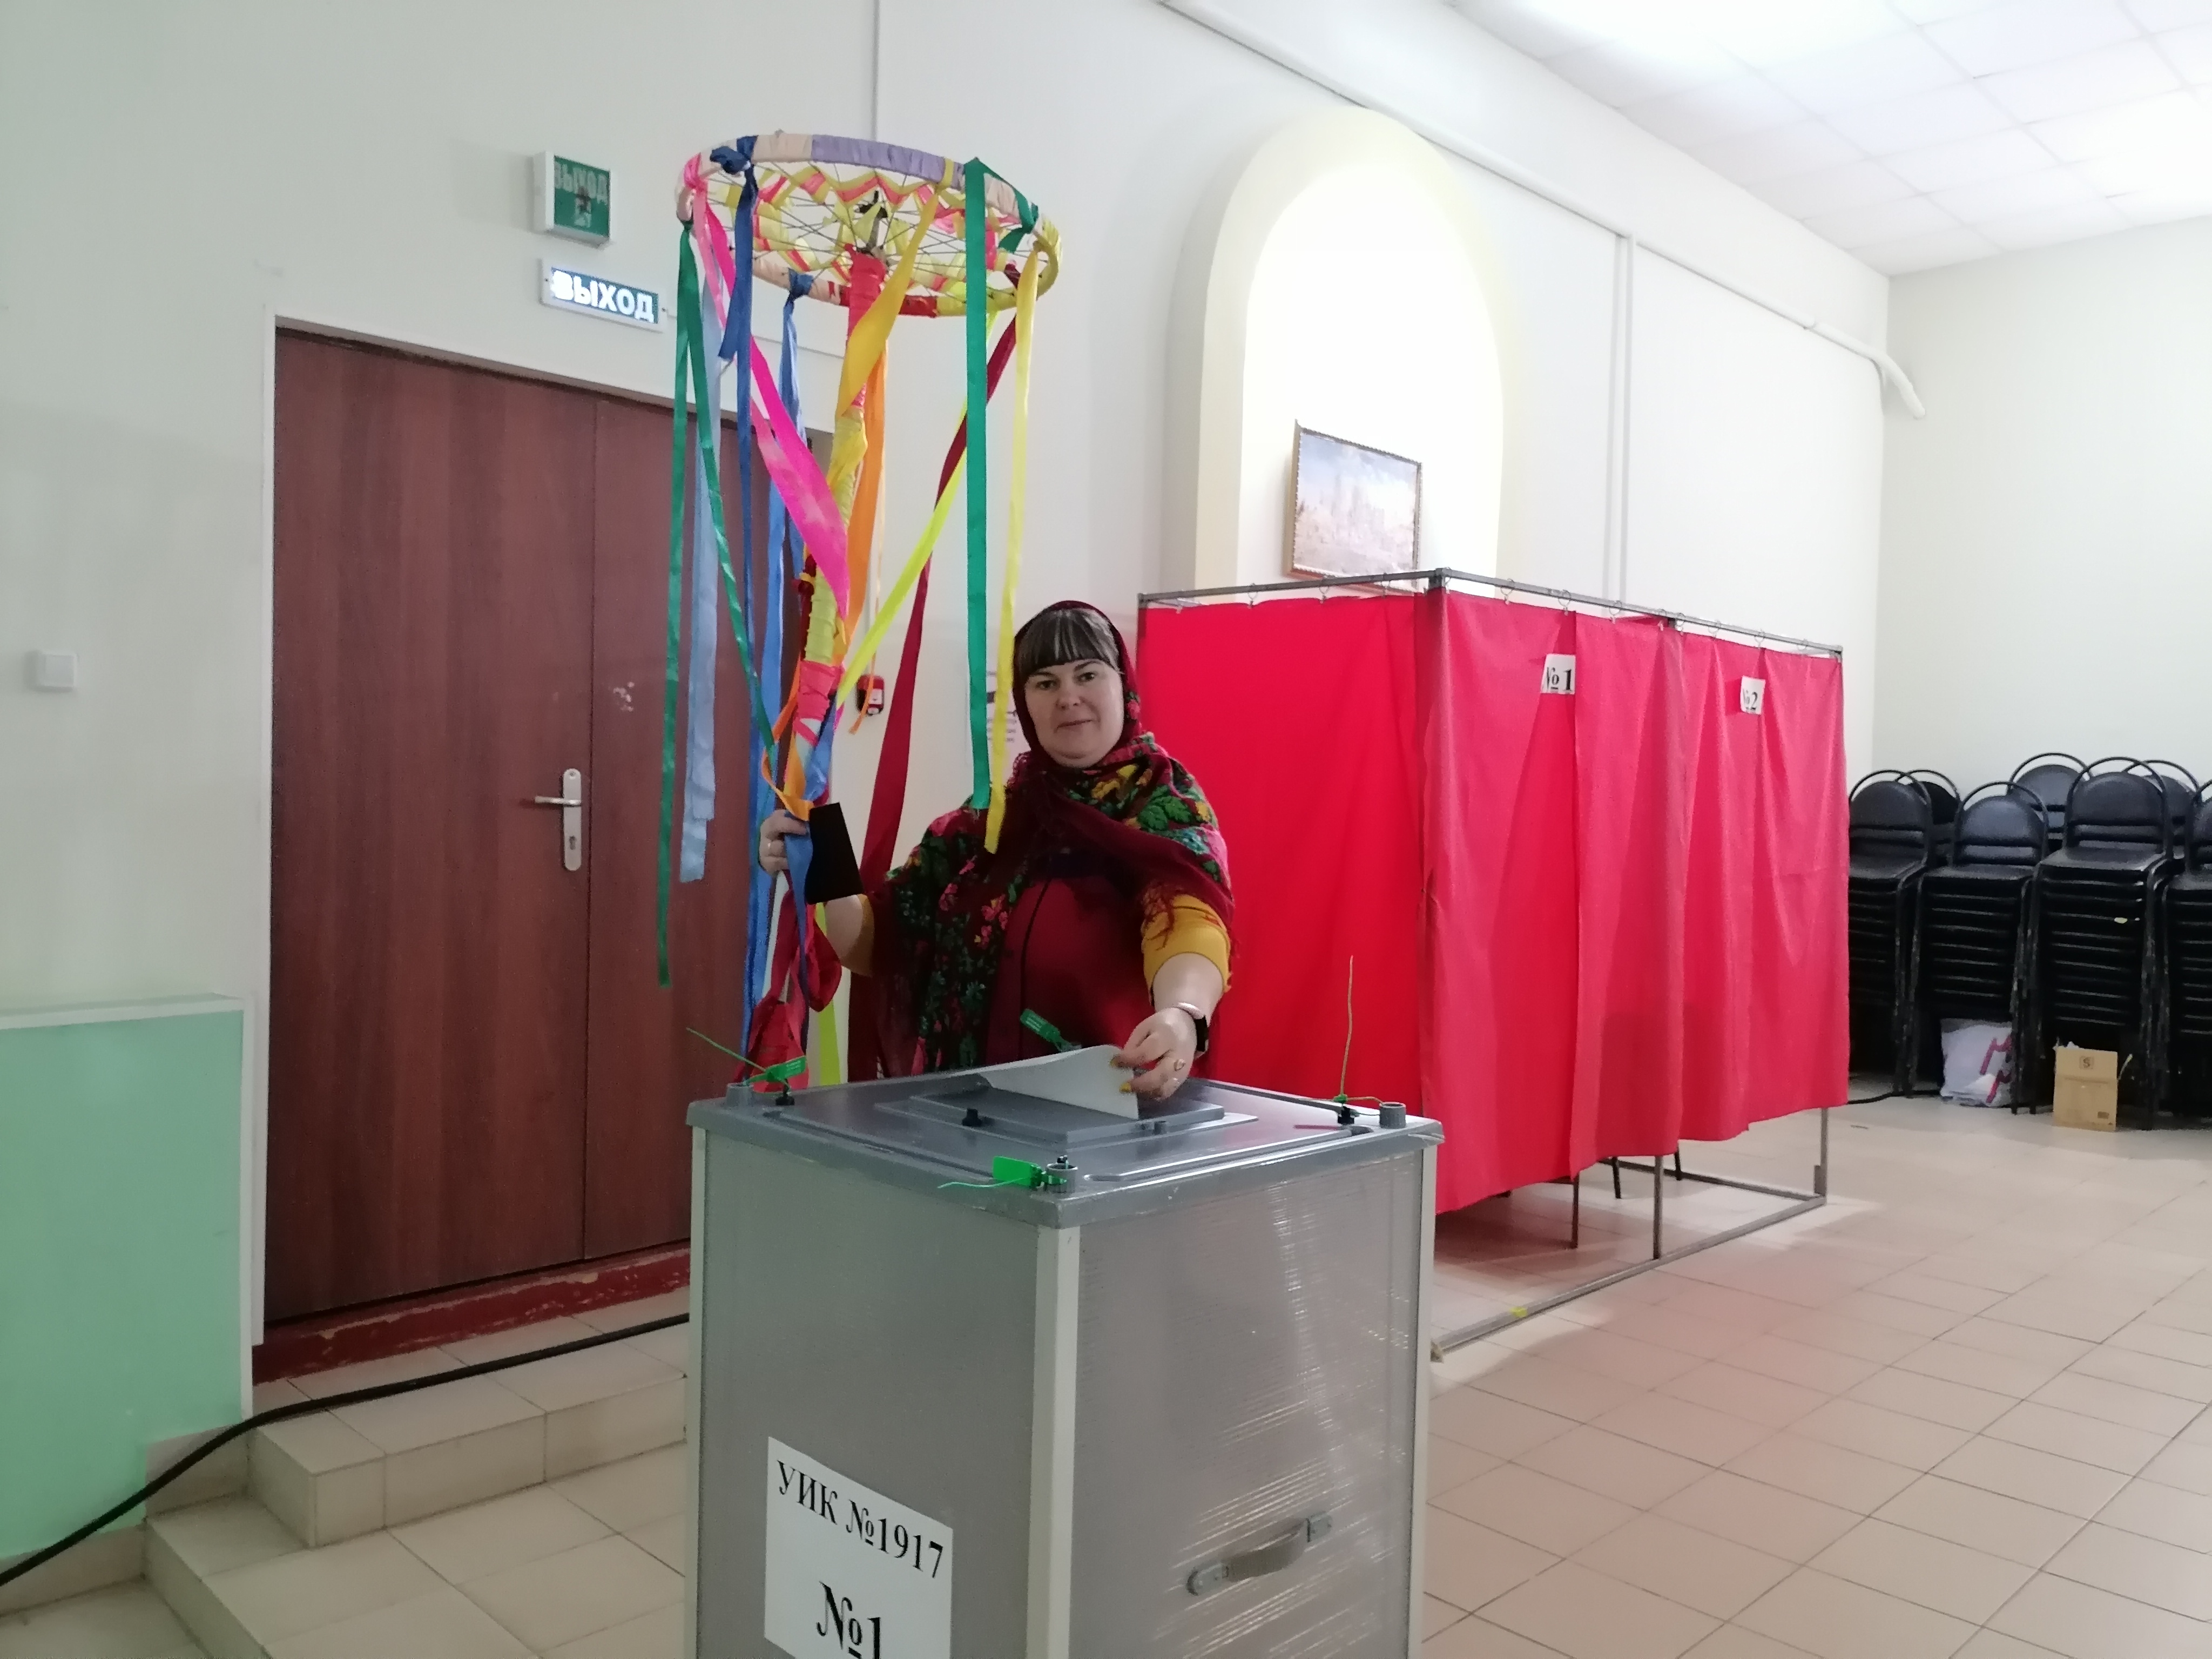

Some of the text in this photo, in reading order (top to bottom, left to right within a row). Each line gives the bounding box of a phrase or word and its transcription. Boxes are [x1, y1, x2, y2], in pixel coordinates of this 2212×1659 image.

[550, 269, 655, 323] ВЫХОД
[777, 1460, 944, 1579] УИК №1917
[816, 1580, 882, 1659] №1
